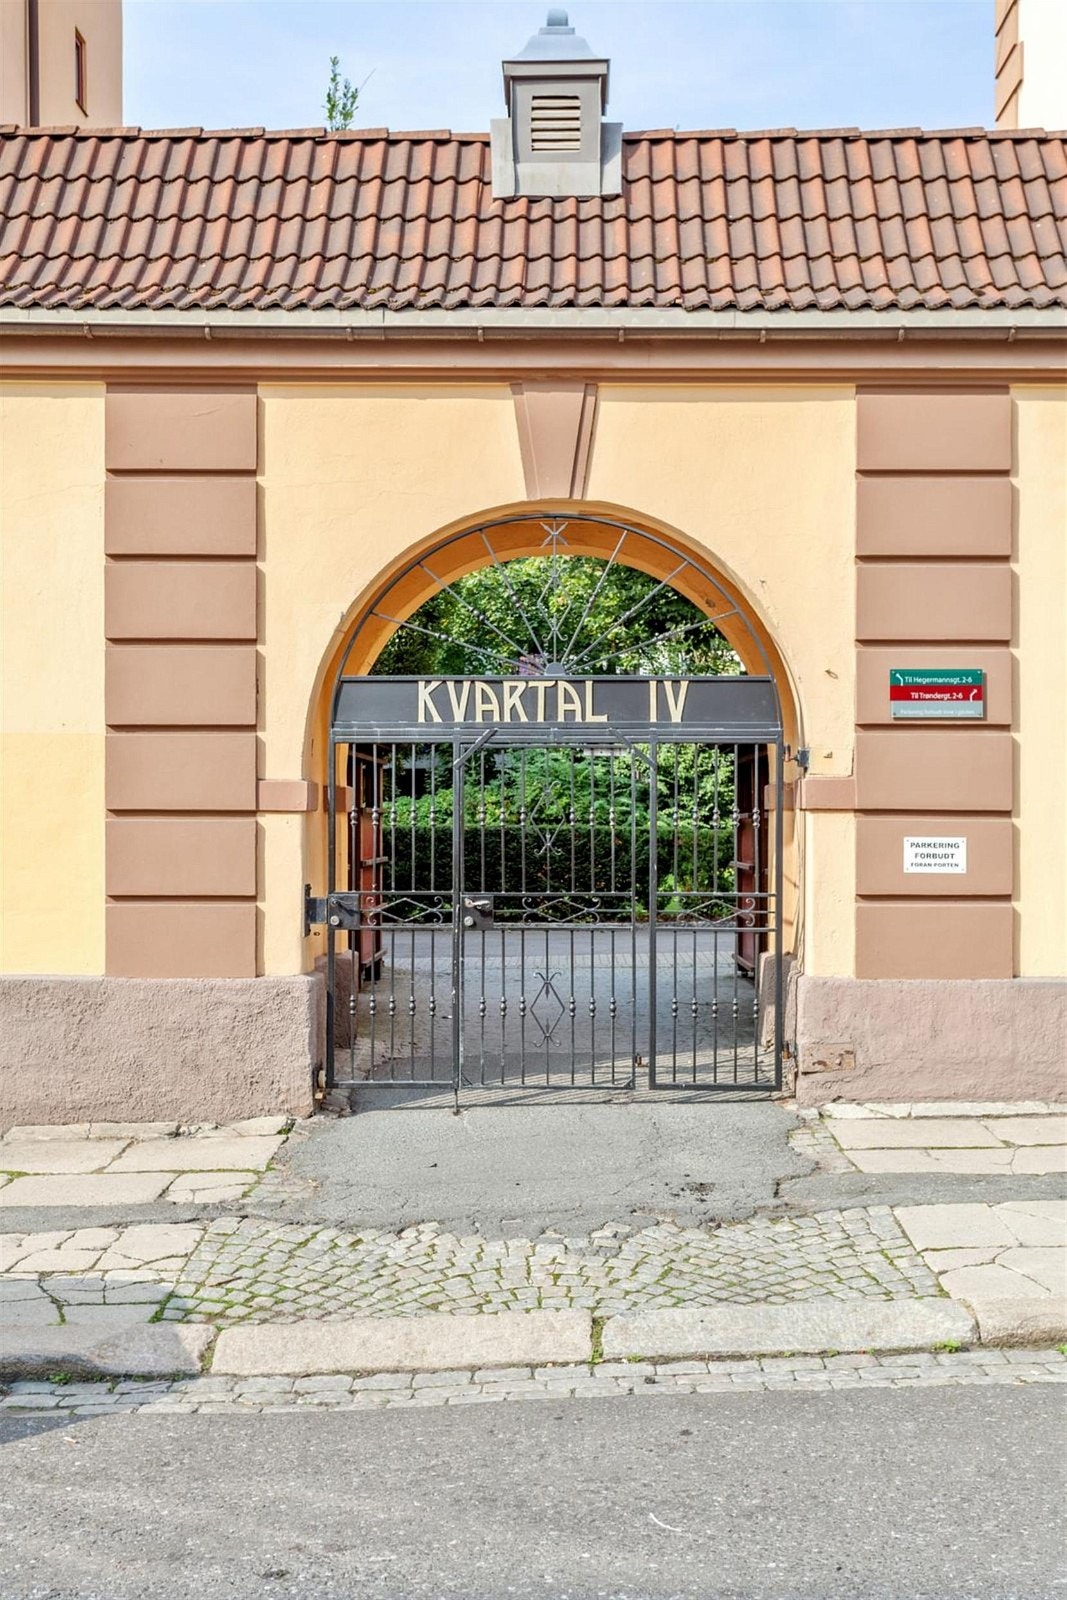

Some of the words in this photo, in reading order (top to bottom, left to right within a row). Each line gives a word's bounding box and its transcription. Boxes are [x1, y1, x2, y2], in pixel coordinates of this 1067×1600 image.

[418, 680, 608, 723] KVARTAL
[649, 680, 690, 723] IV
[914, 852, 955, 860] FORBUDT
